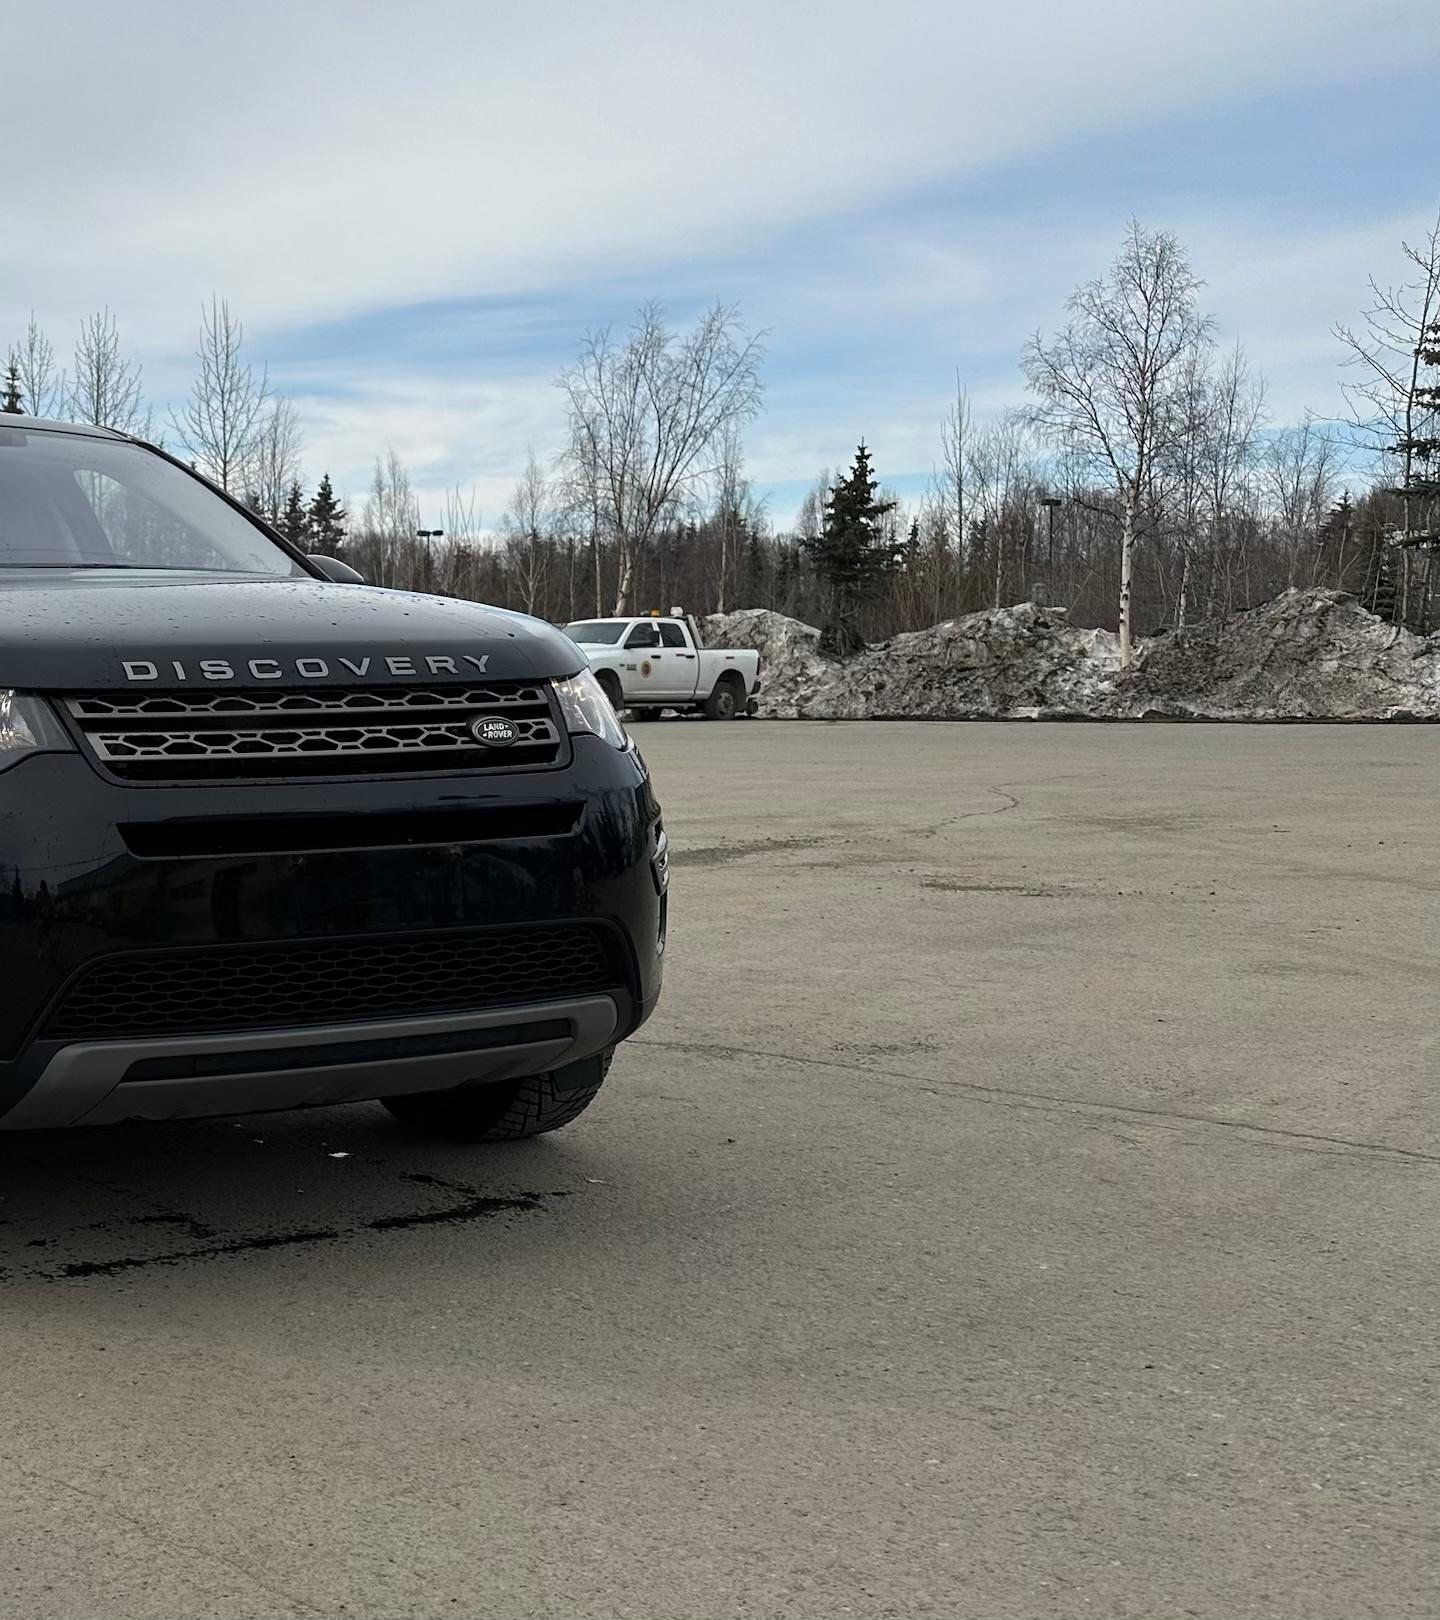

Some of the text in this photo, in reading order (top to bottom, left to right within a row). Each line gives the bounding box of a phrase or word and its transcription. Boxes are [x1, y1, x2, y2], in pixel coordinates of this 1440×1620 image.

[121, 655, 490, 681] DISCOVERY
[483, 723, 505, 731] LAND
[488, 730, 513, 738] ROVER
